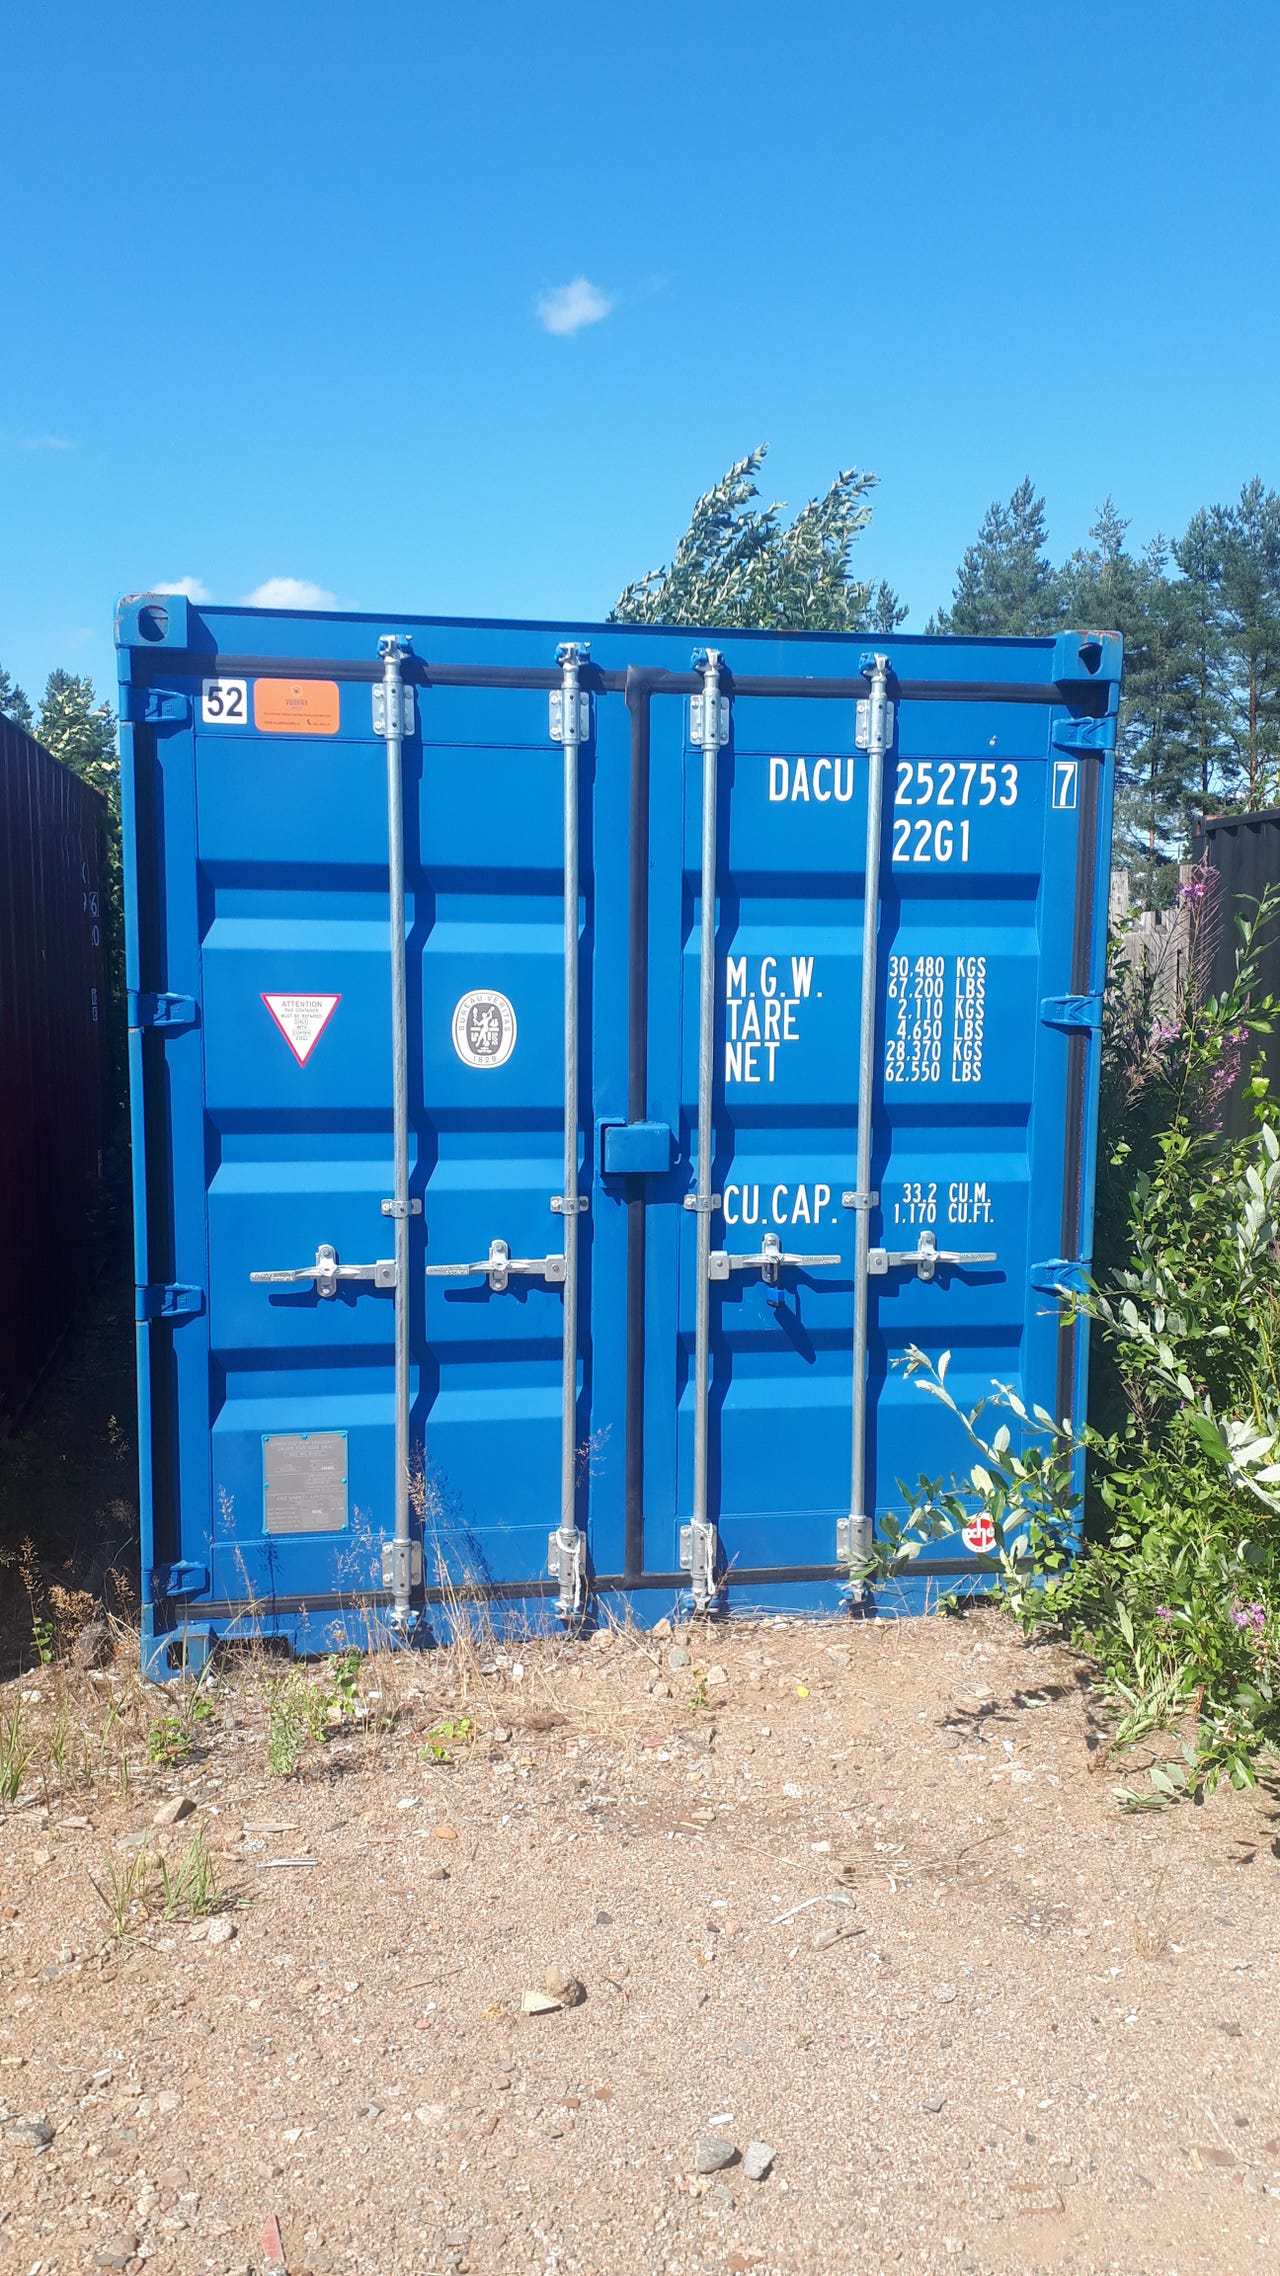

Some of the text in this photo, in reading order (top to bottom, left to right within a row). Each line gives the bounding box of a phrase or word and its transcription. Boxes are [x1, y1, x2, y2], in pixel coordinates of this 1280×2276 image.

[207, 685, 243, 717] 52
[769, 757, 1075, 807] DACU 252753 7
[892, 819, 970, 862] 22G1
[726, 956, 824, 998] M.G.W.
[956, 956, 986, 978] KGS
[955, 977, 986, 998] LBS
[281, 1000, 323, 1008] ATTENTION
[459, 995, 511, 1032] BUREAU VERITAS
[954, 998, 985, 1020] KGS
[726, 999, 800, 1040] TARE
[953, 1019, 984, 1041] LBS
[473, 1055, 498, 1063] 1828
[725, 1041, 781, 1082] NET
[952, 1040, 983, 1061] KGS
[951, 1061, 982, 1082] LBS
[902, 1183, 992, 1203] 33.2 CU.M.
[723, 1184, 838, 1225] CU.CAP.
[948, 1203, 995, 1223] CU.FT.
